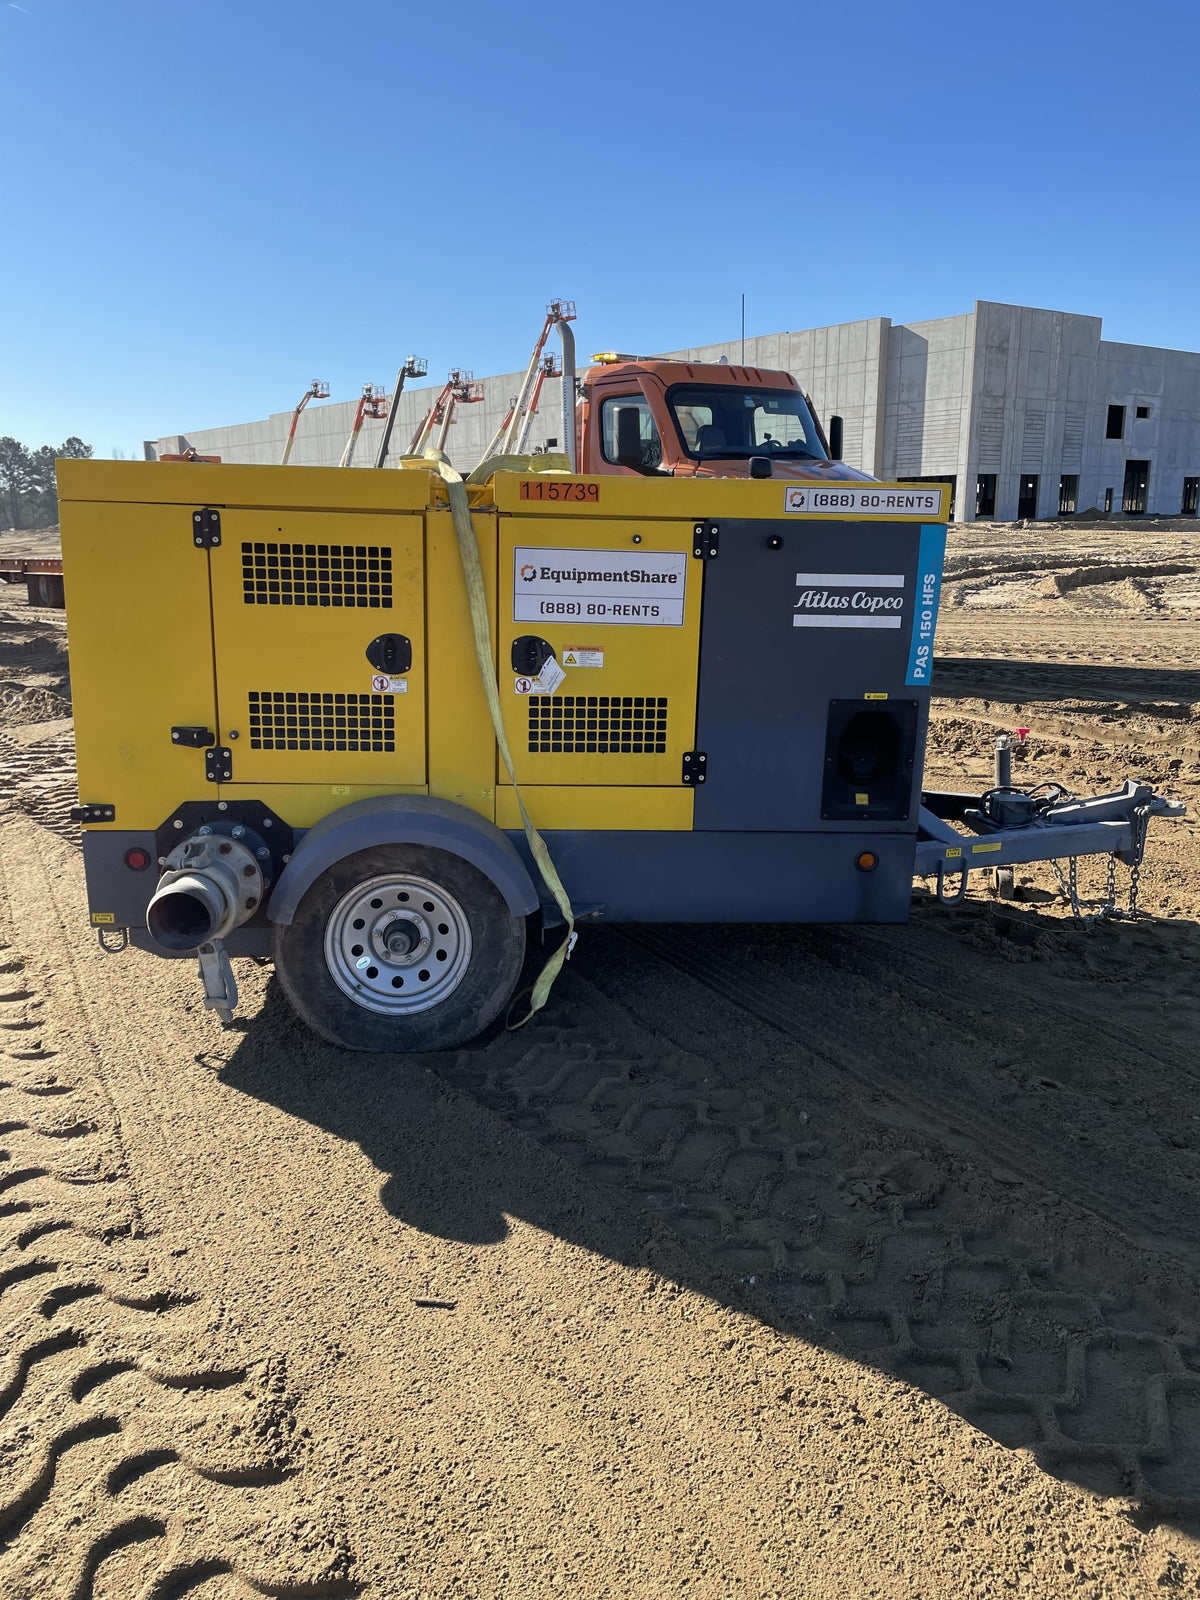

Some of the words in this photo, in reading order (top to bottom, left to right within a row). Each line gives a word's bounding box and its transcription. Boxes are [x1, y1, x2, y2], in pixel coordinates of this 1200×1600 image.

[522, 482, 599, 501] 115739
[814, 493, 855, 507] (888)
[860, 495, 934, 508] 80-RENTS
[540, 567, 678, 584] EquipmentShare
[922, 573, 936, 605] HFS
[540, 601, 581, 615] (888)
[587, 604, 660, 617] 80-RENTS
[793, 590, 850, 609] Atlas
[851, 591, 904, 613] Copco
[919, 612, 933, 639] 150
[913, 645, 930, 678] PAS
